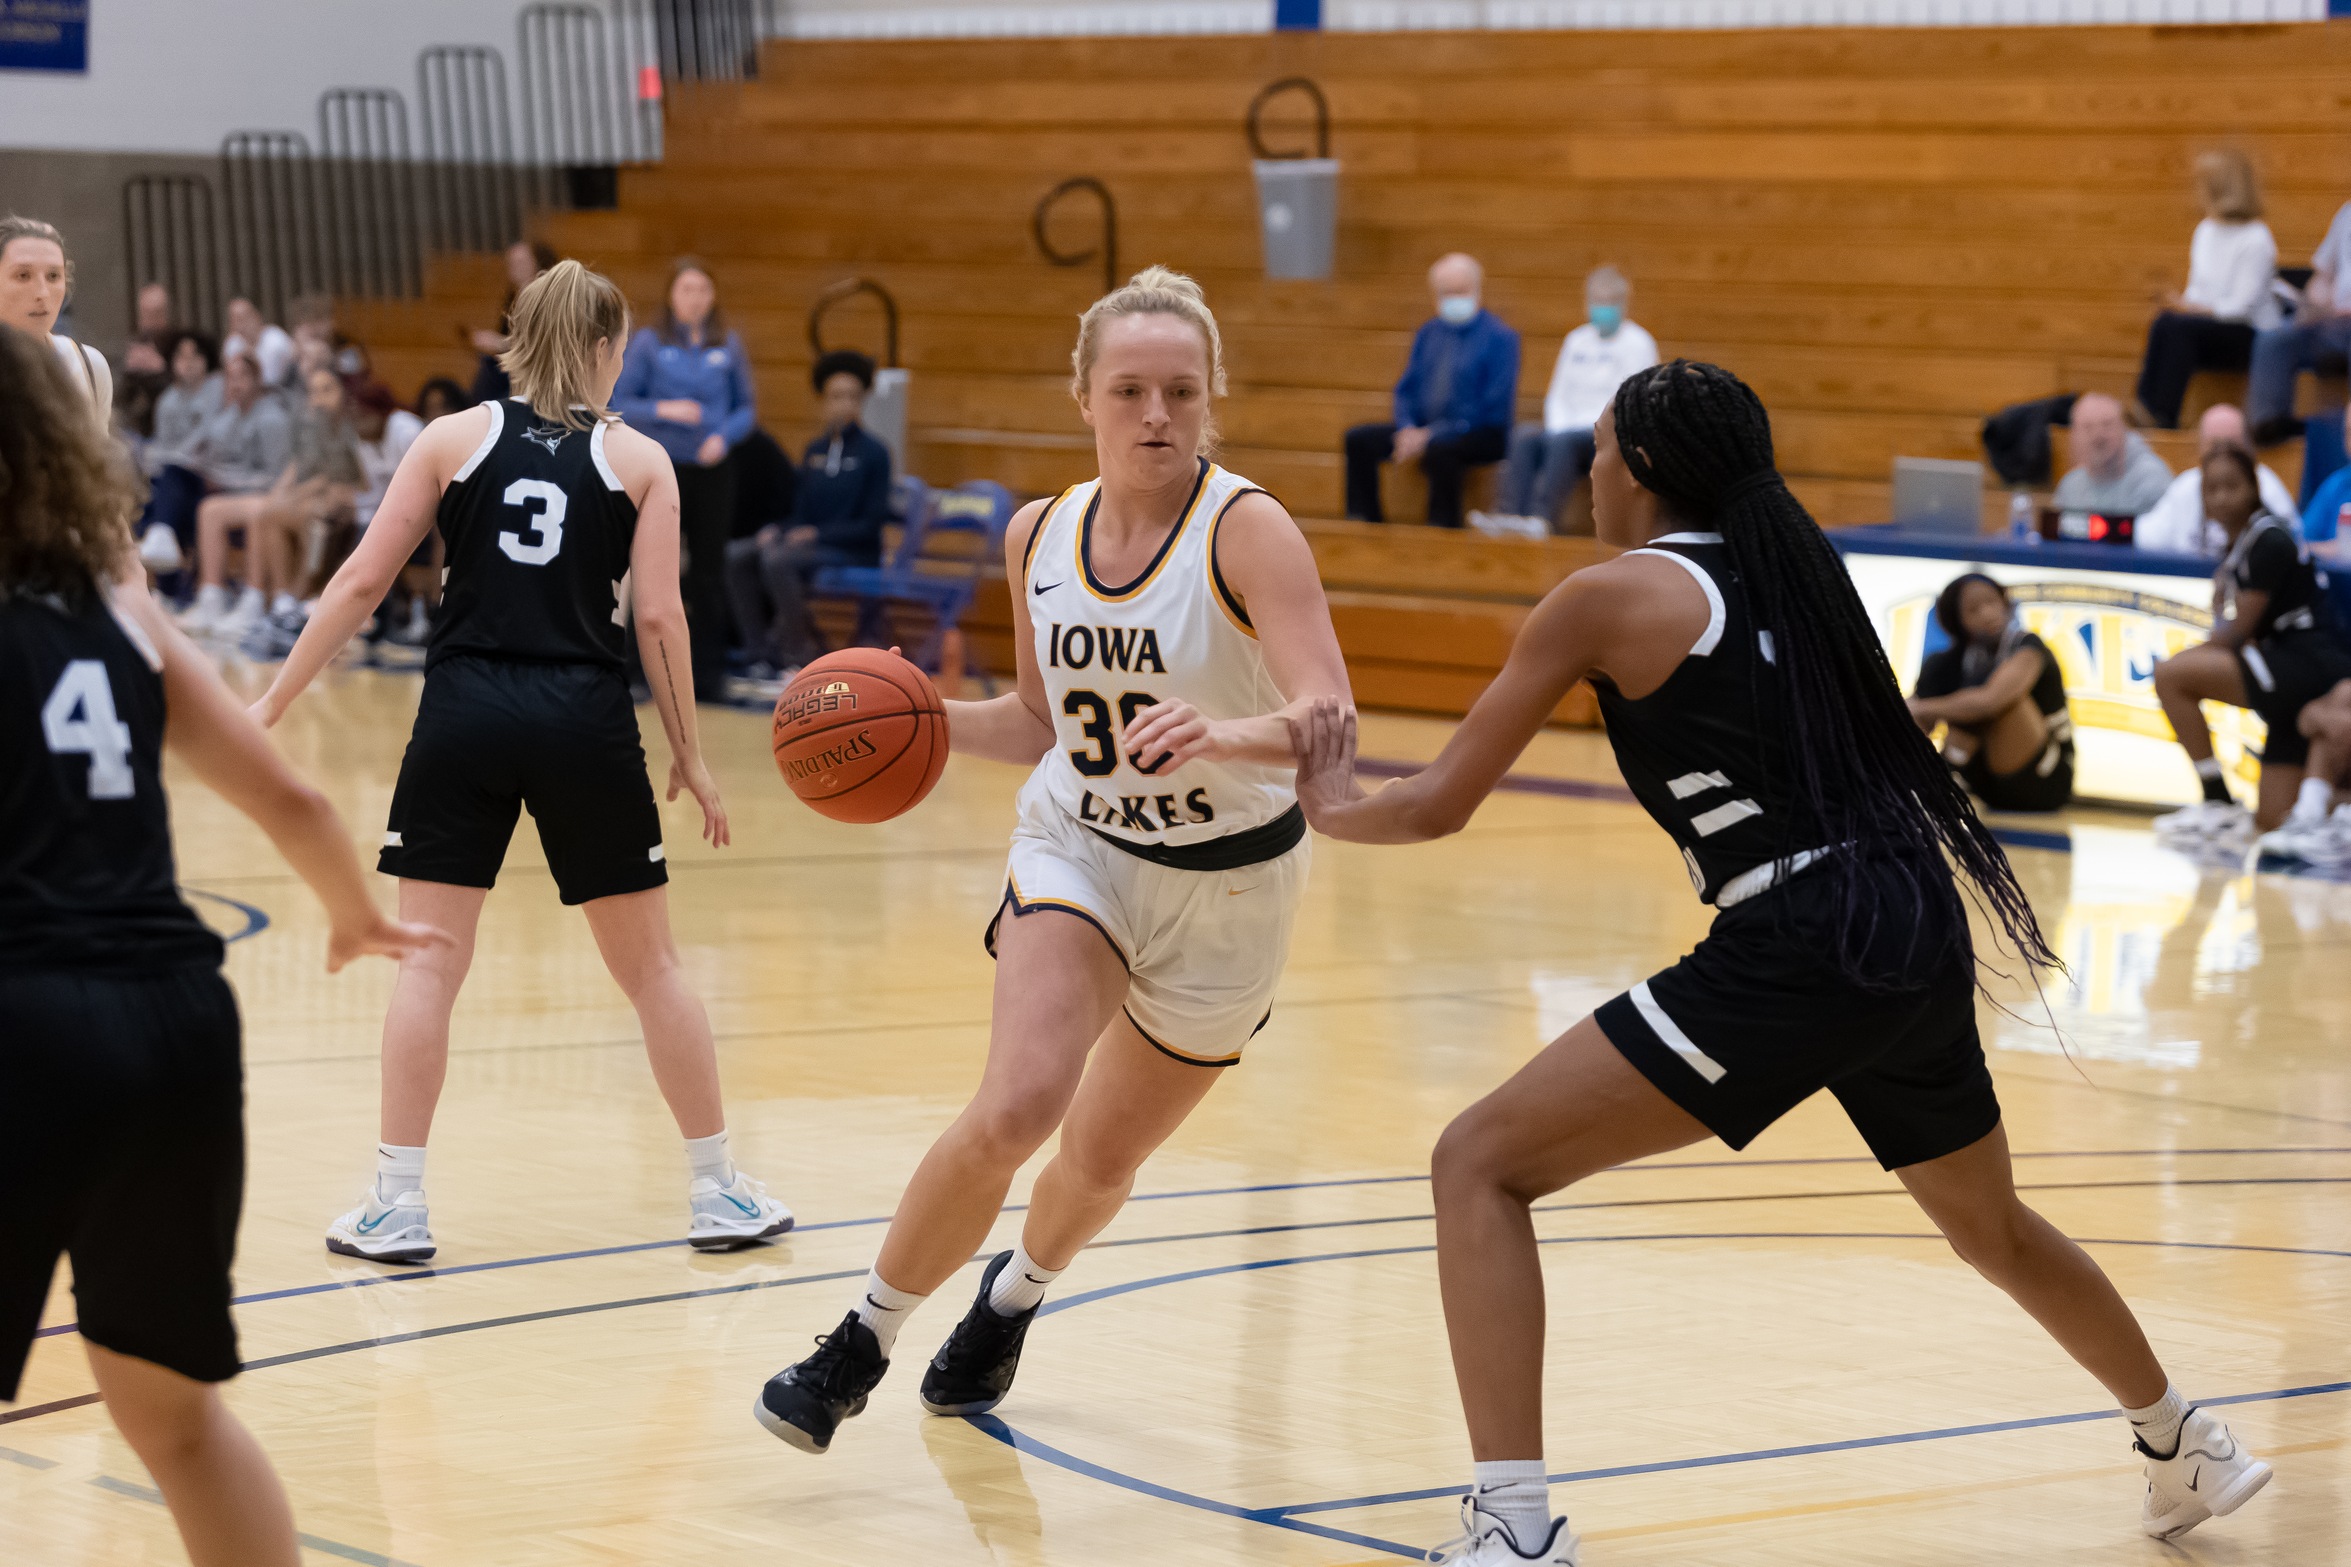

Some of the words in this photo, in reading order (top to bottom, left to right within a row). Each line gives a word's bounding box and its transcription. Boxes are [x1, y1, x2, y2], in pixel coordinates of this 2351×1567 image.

[498, 477, 568, 566] 3
[1049, 622, 1168, 674] IOWA
[41, 658, 136, 799] 4
